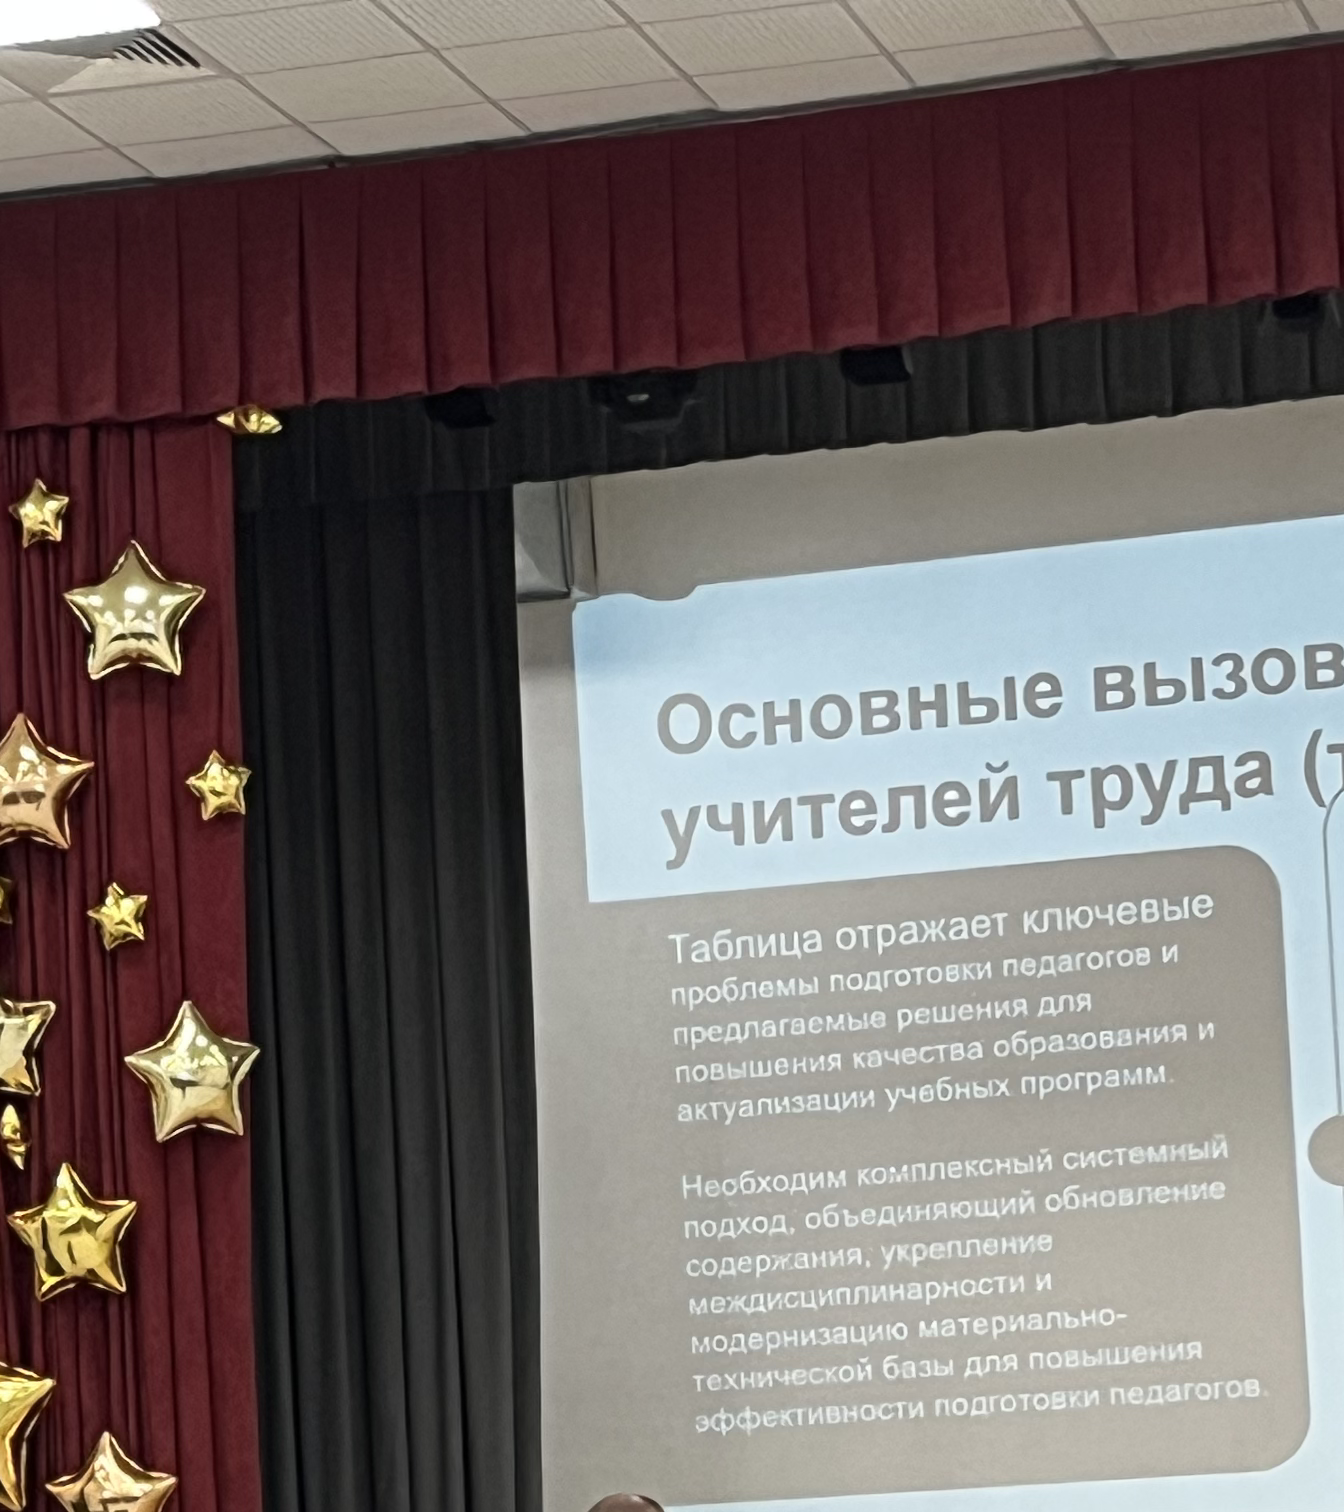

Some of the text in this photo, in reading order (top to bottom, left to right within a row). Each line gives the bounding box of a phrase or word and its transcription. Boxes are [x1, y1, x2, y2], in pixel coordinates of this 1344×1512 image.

[656, 671, 1063, 754] Основные
[660, 760, 1020, 870] учителей
[1045, 748, 1274, 829] труда
[667, 893, 1215, 964] Таблица отражает ключевые
[671, 944, 1179, 1012] проблемы подготовки педагогов и
[673, 992, 1092, 1051] предлагаемые решения для
[675, 1021, 1215, 1084] повышения качества образования и
[677, 1089, 876, 1126] актуализации
[884, 1076, 1011, 1113] учебных
[682, 1133, 1229, 1200] Необходим комплексный системный
[683, 1180, 1226, 1240] подход, объединяющий обновление
[685, 1233, 1053, 1280] содержания, укрепление
[688, 1272, 1052, 1316] междисциплинарности и
[690, 1307, 1128, 1355] модернизацию материально-
[692, 1340, 1203, 1392] технической базы для повышения
[695, 1400, 925, 1437] эффективности
[934, 1389, 1100, 1418] подготовки
